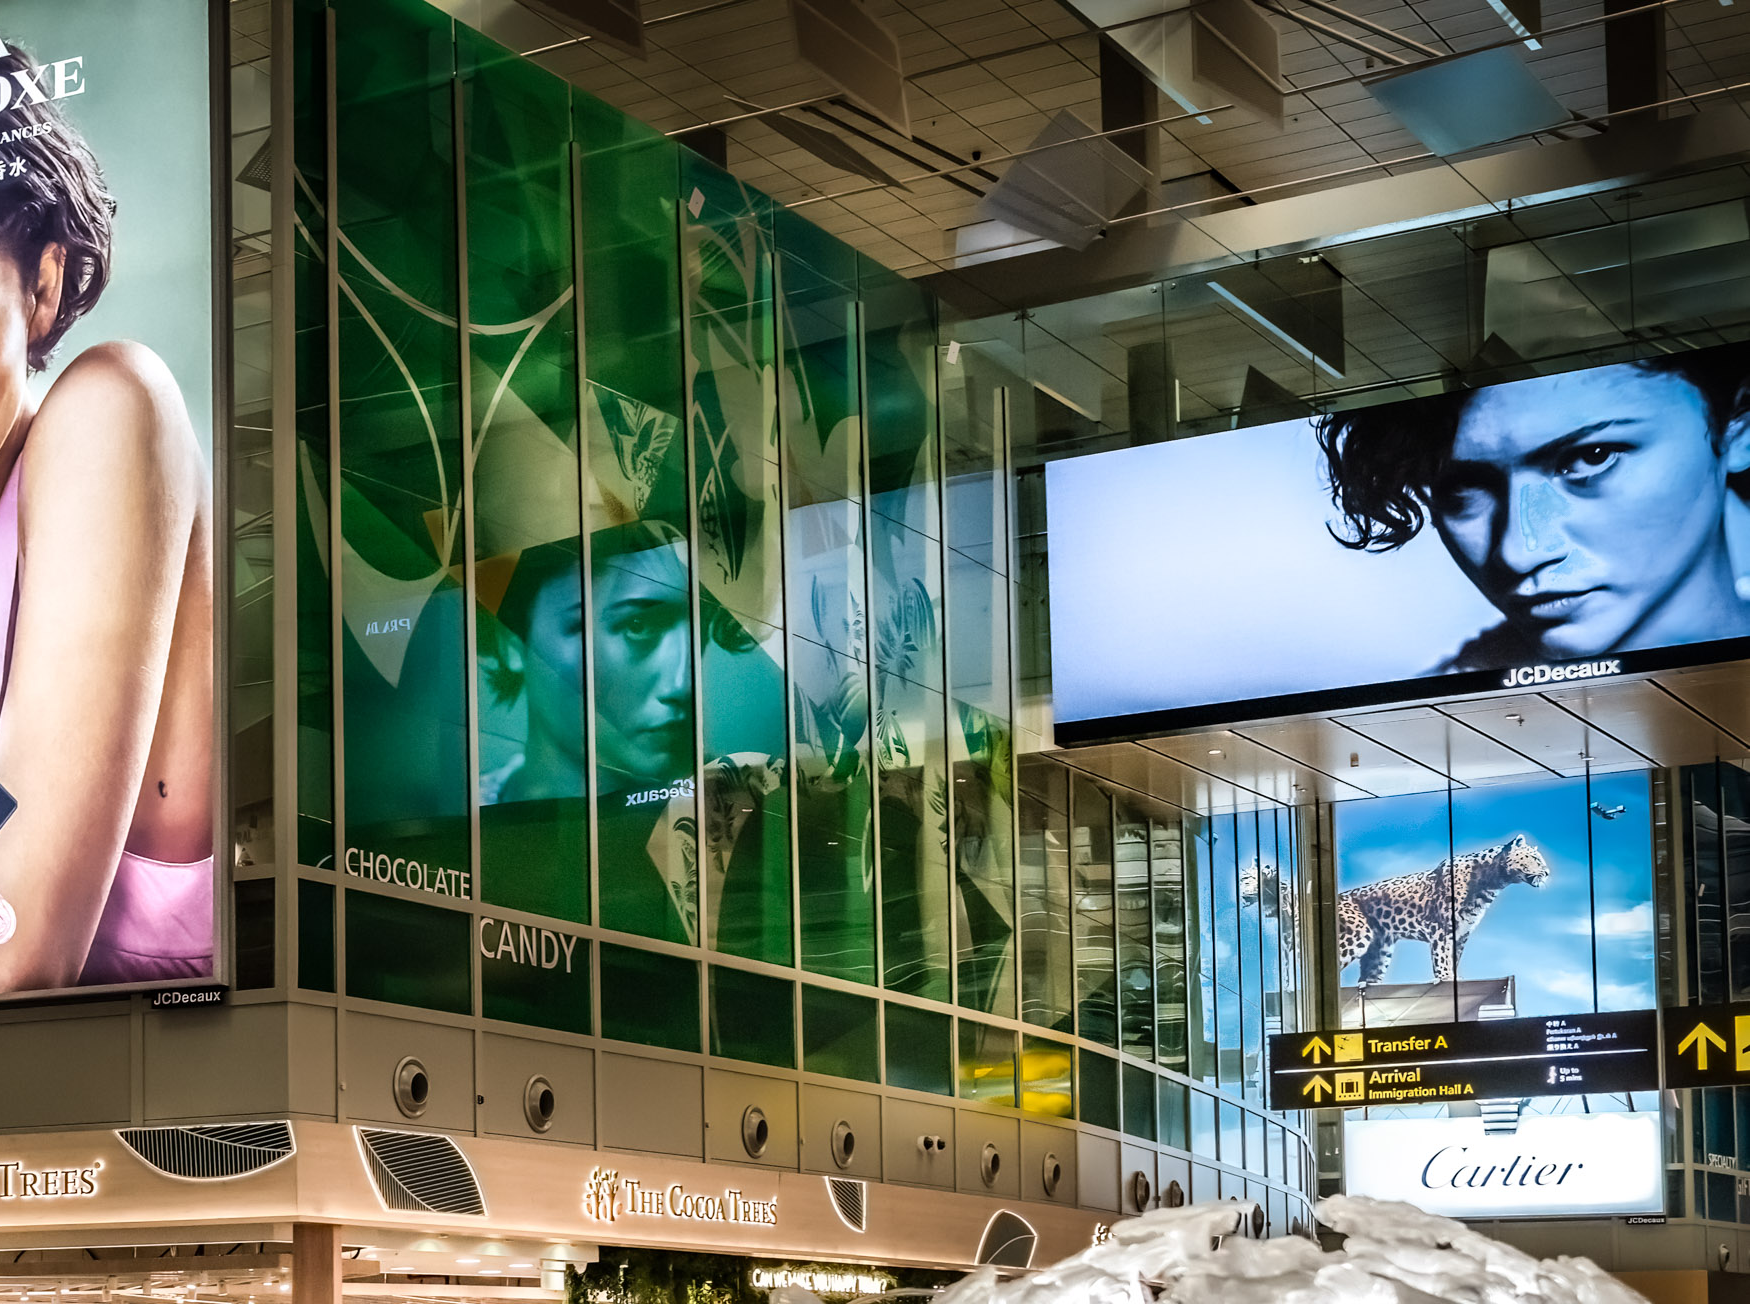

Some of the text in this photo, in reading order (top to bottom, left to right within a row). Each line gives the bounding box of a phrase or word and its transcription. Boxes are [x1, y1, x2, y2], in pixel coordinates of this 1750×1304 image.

[1503, 660, 1620, 687] JCDecaux
[345, 847, 470, 900] CHOCOLATE
[480, 918, 577, 973] CANDY
[154, 991, 221, 1005] JCDecaux
[1368, 1035, 1448, 1054] Transfer A
[1369, 1068, 1421, 1085] Arrival
[1369, 1083, 1473, 1099] Immigration Hall A
[1421, 1146, 1584, 1189] Cartier
